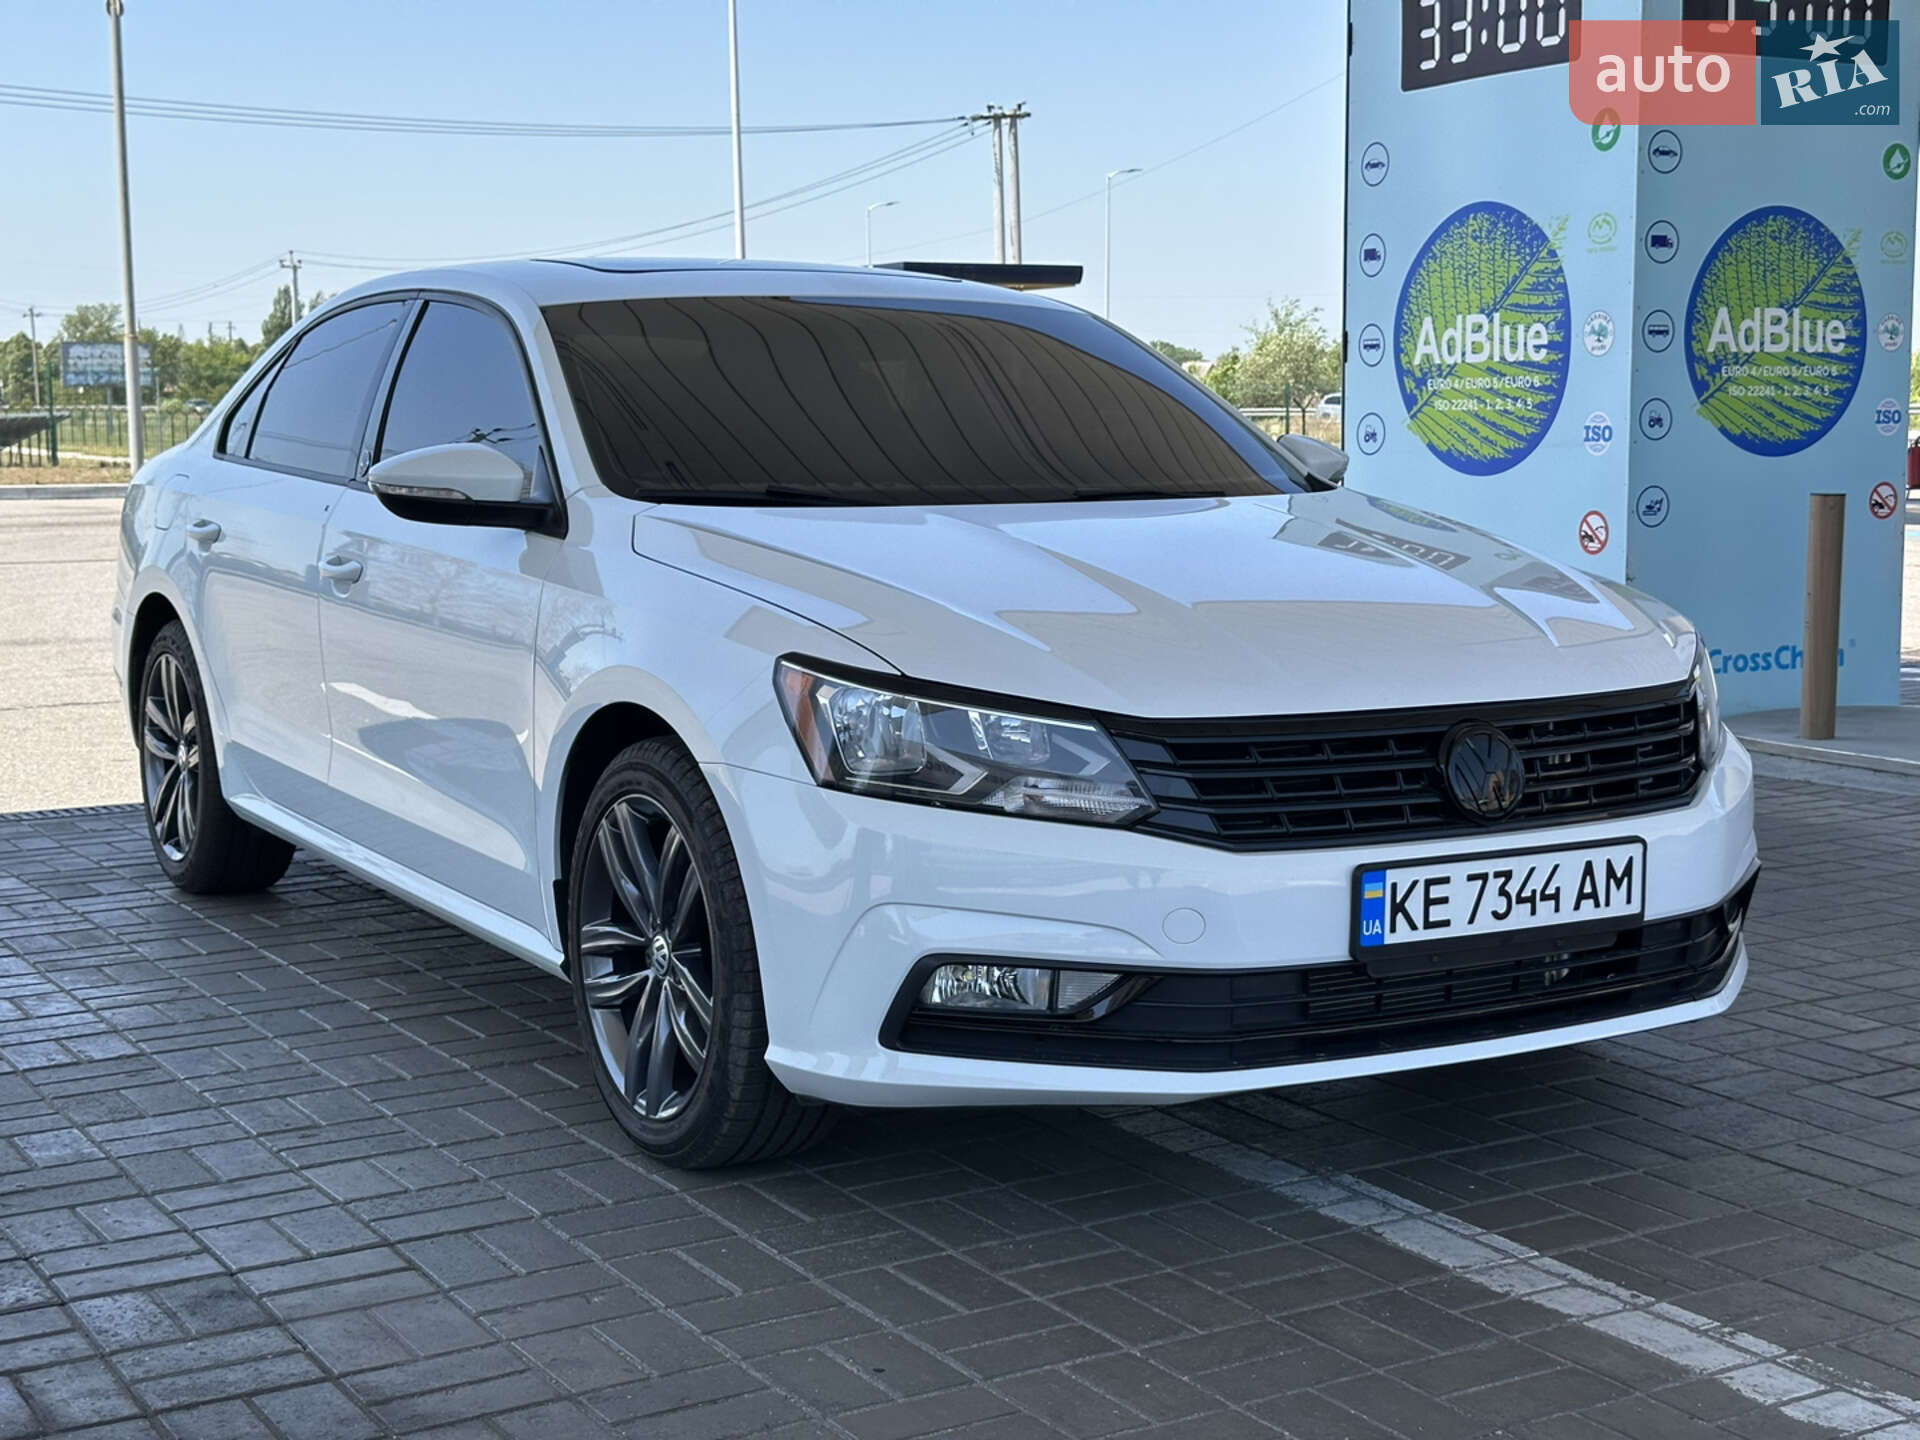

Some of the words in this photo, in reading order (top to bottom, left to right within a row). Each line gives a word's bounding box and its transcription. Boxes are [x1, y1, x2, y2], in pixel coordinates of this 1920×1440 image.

[1729, 386, 1745, 397] ISO
[1435, 400, 1449, 411] ISO
[1875, 410, 1902, 424] ISO
[1584, 425, 1613, 442] ISO
[1709, 645, 1844, 674] CrossCh
[1389, 875, 1451, 934] KE
[1466, 863, 1561, 925] 7344
[1573, 856, 1634, 911] AM
[1363, 919, 1382, 936] UA
